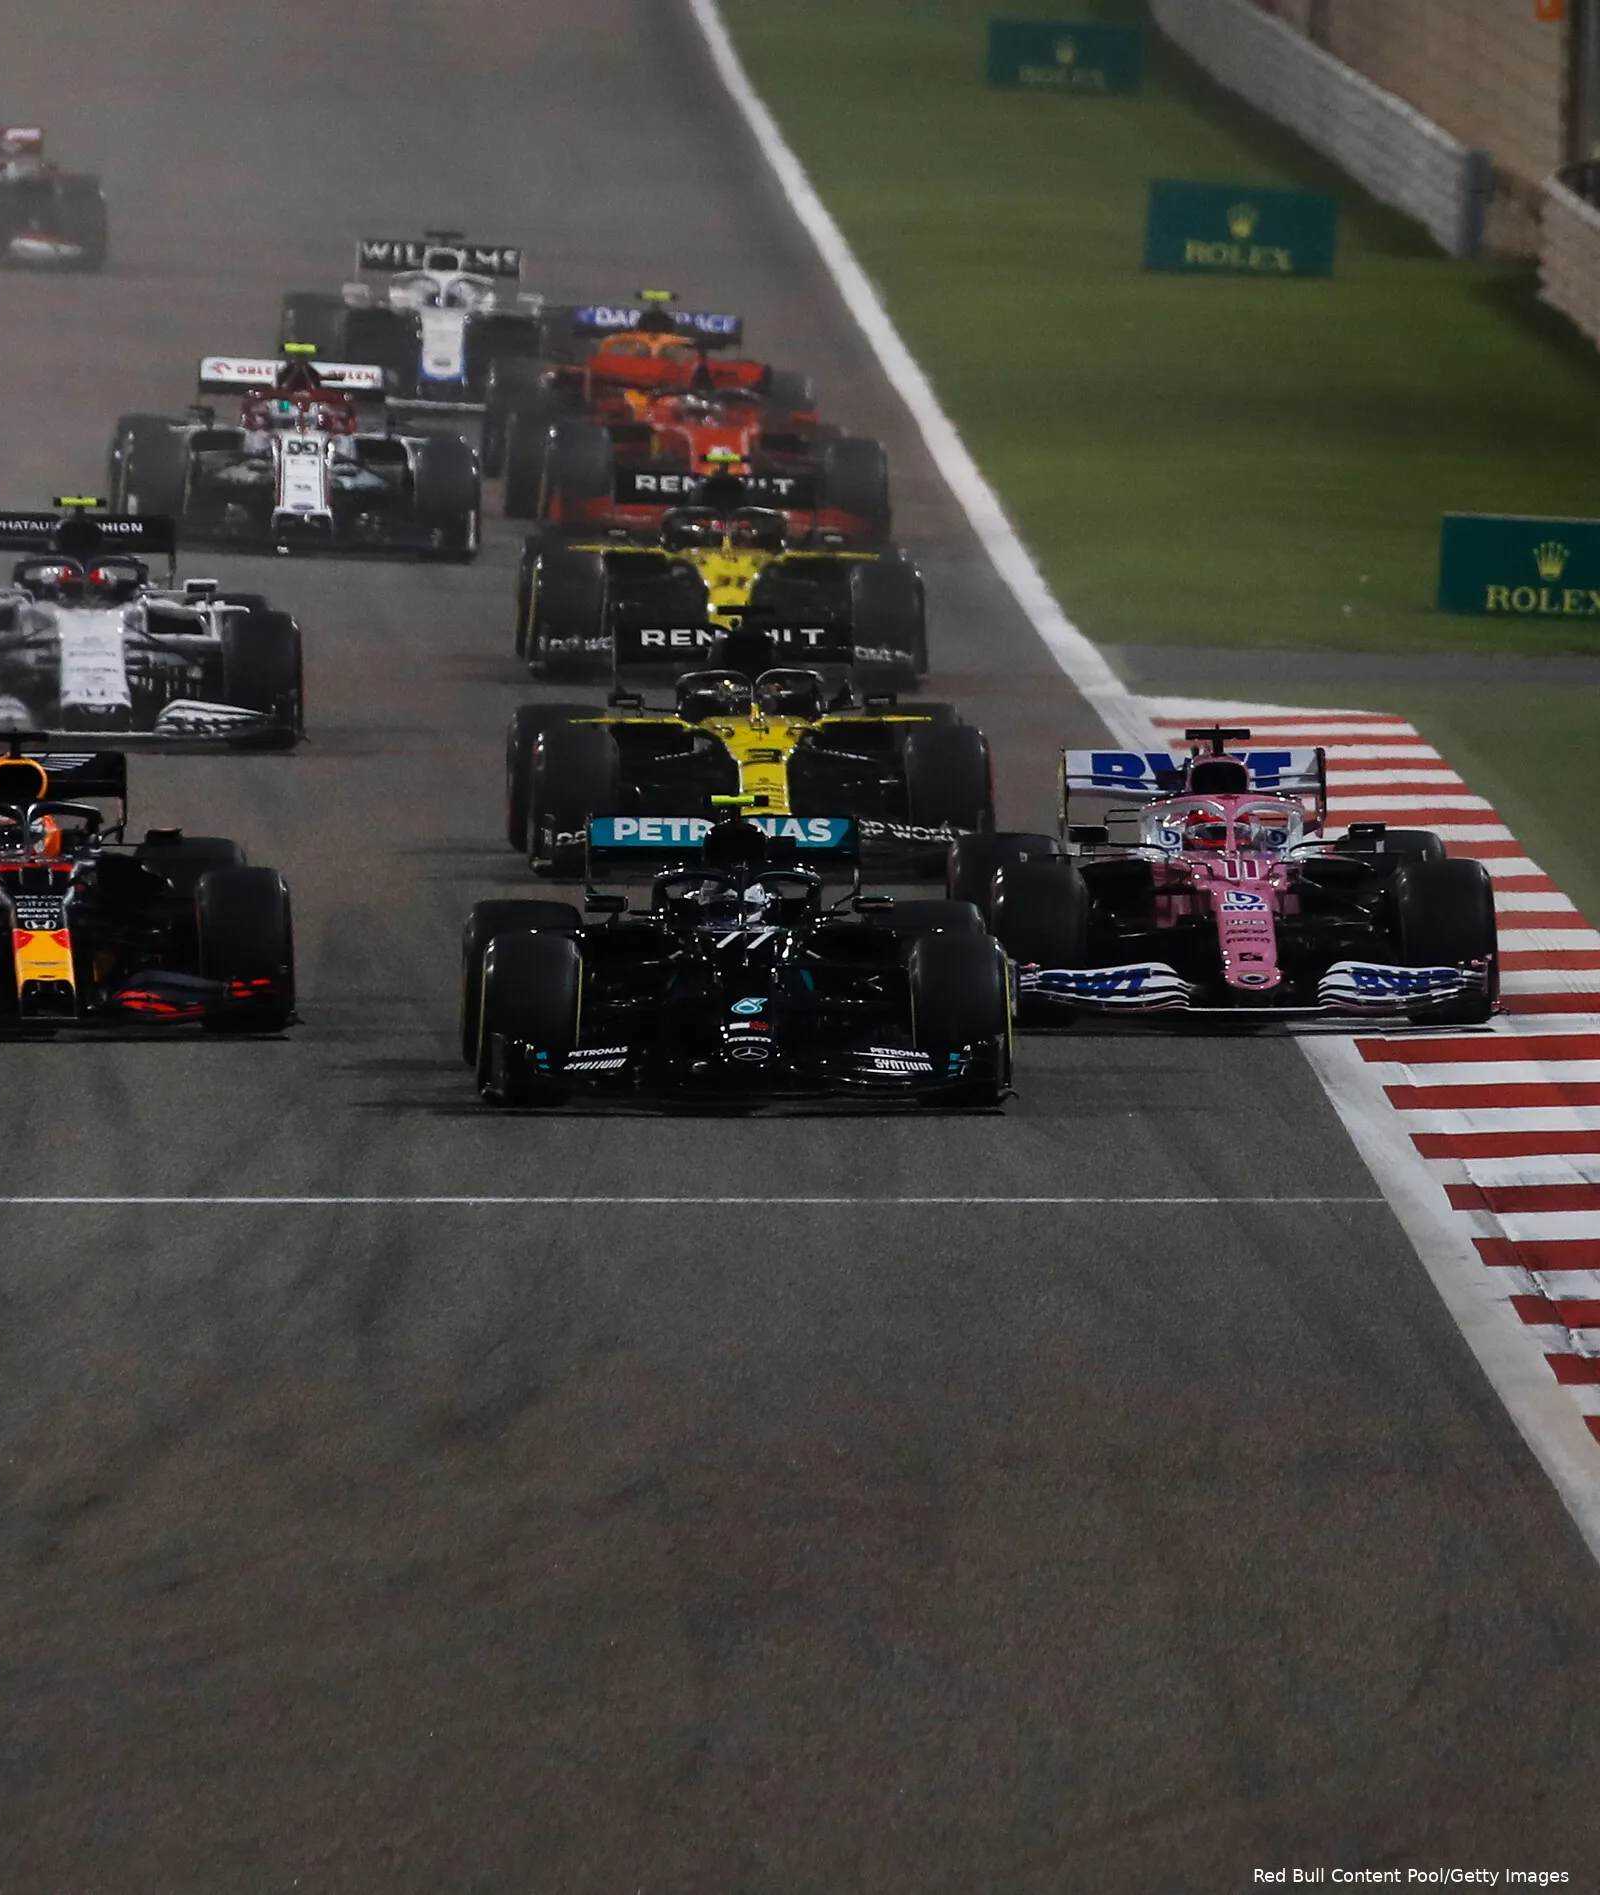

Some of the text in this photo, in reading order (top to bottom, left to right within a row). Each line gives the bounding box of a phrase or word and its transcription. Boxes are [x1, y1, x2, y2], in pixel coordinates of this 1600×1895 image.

[362, 242, 518, 268] WILMS
[1185, 239, 1291, 271] ROLEX
[613, 817, 832, 842] PETRNAS
[1221, 859, 1260, 880] 11
[1222, 904, 1267, 912] BWT
[712, 930, 776, 949] 77
[567, 1046, 629, 1057] PETRONAS
[870, 1047, 930, 1058] PETRONAS
[874, 1058, 933, 1071] SYNTIUM
